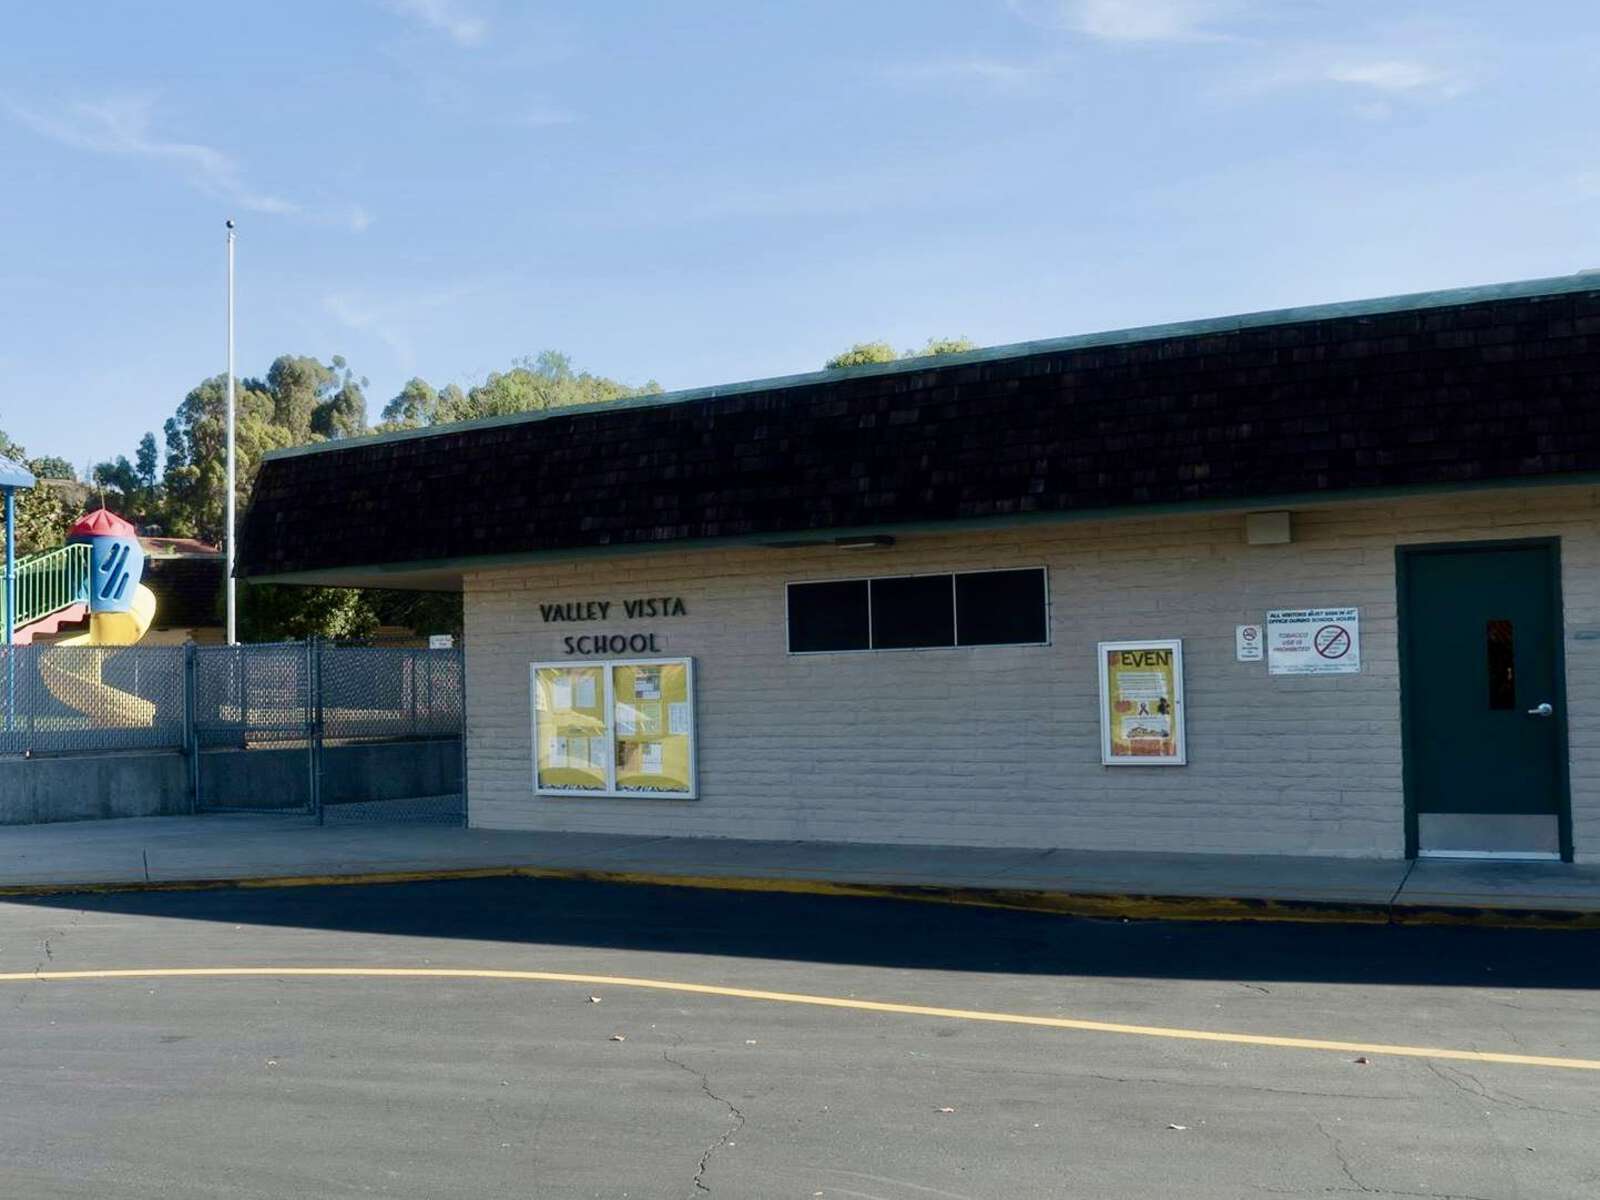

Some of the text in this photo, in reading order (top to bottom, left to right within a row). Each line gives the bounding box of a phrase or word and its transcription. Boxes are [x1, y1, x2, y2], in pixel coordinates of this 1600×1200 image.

[539, 597, 687, 623] VALLEY VISTA
[563, 633, 662, 655] SCHOOL
